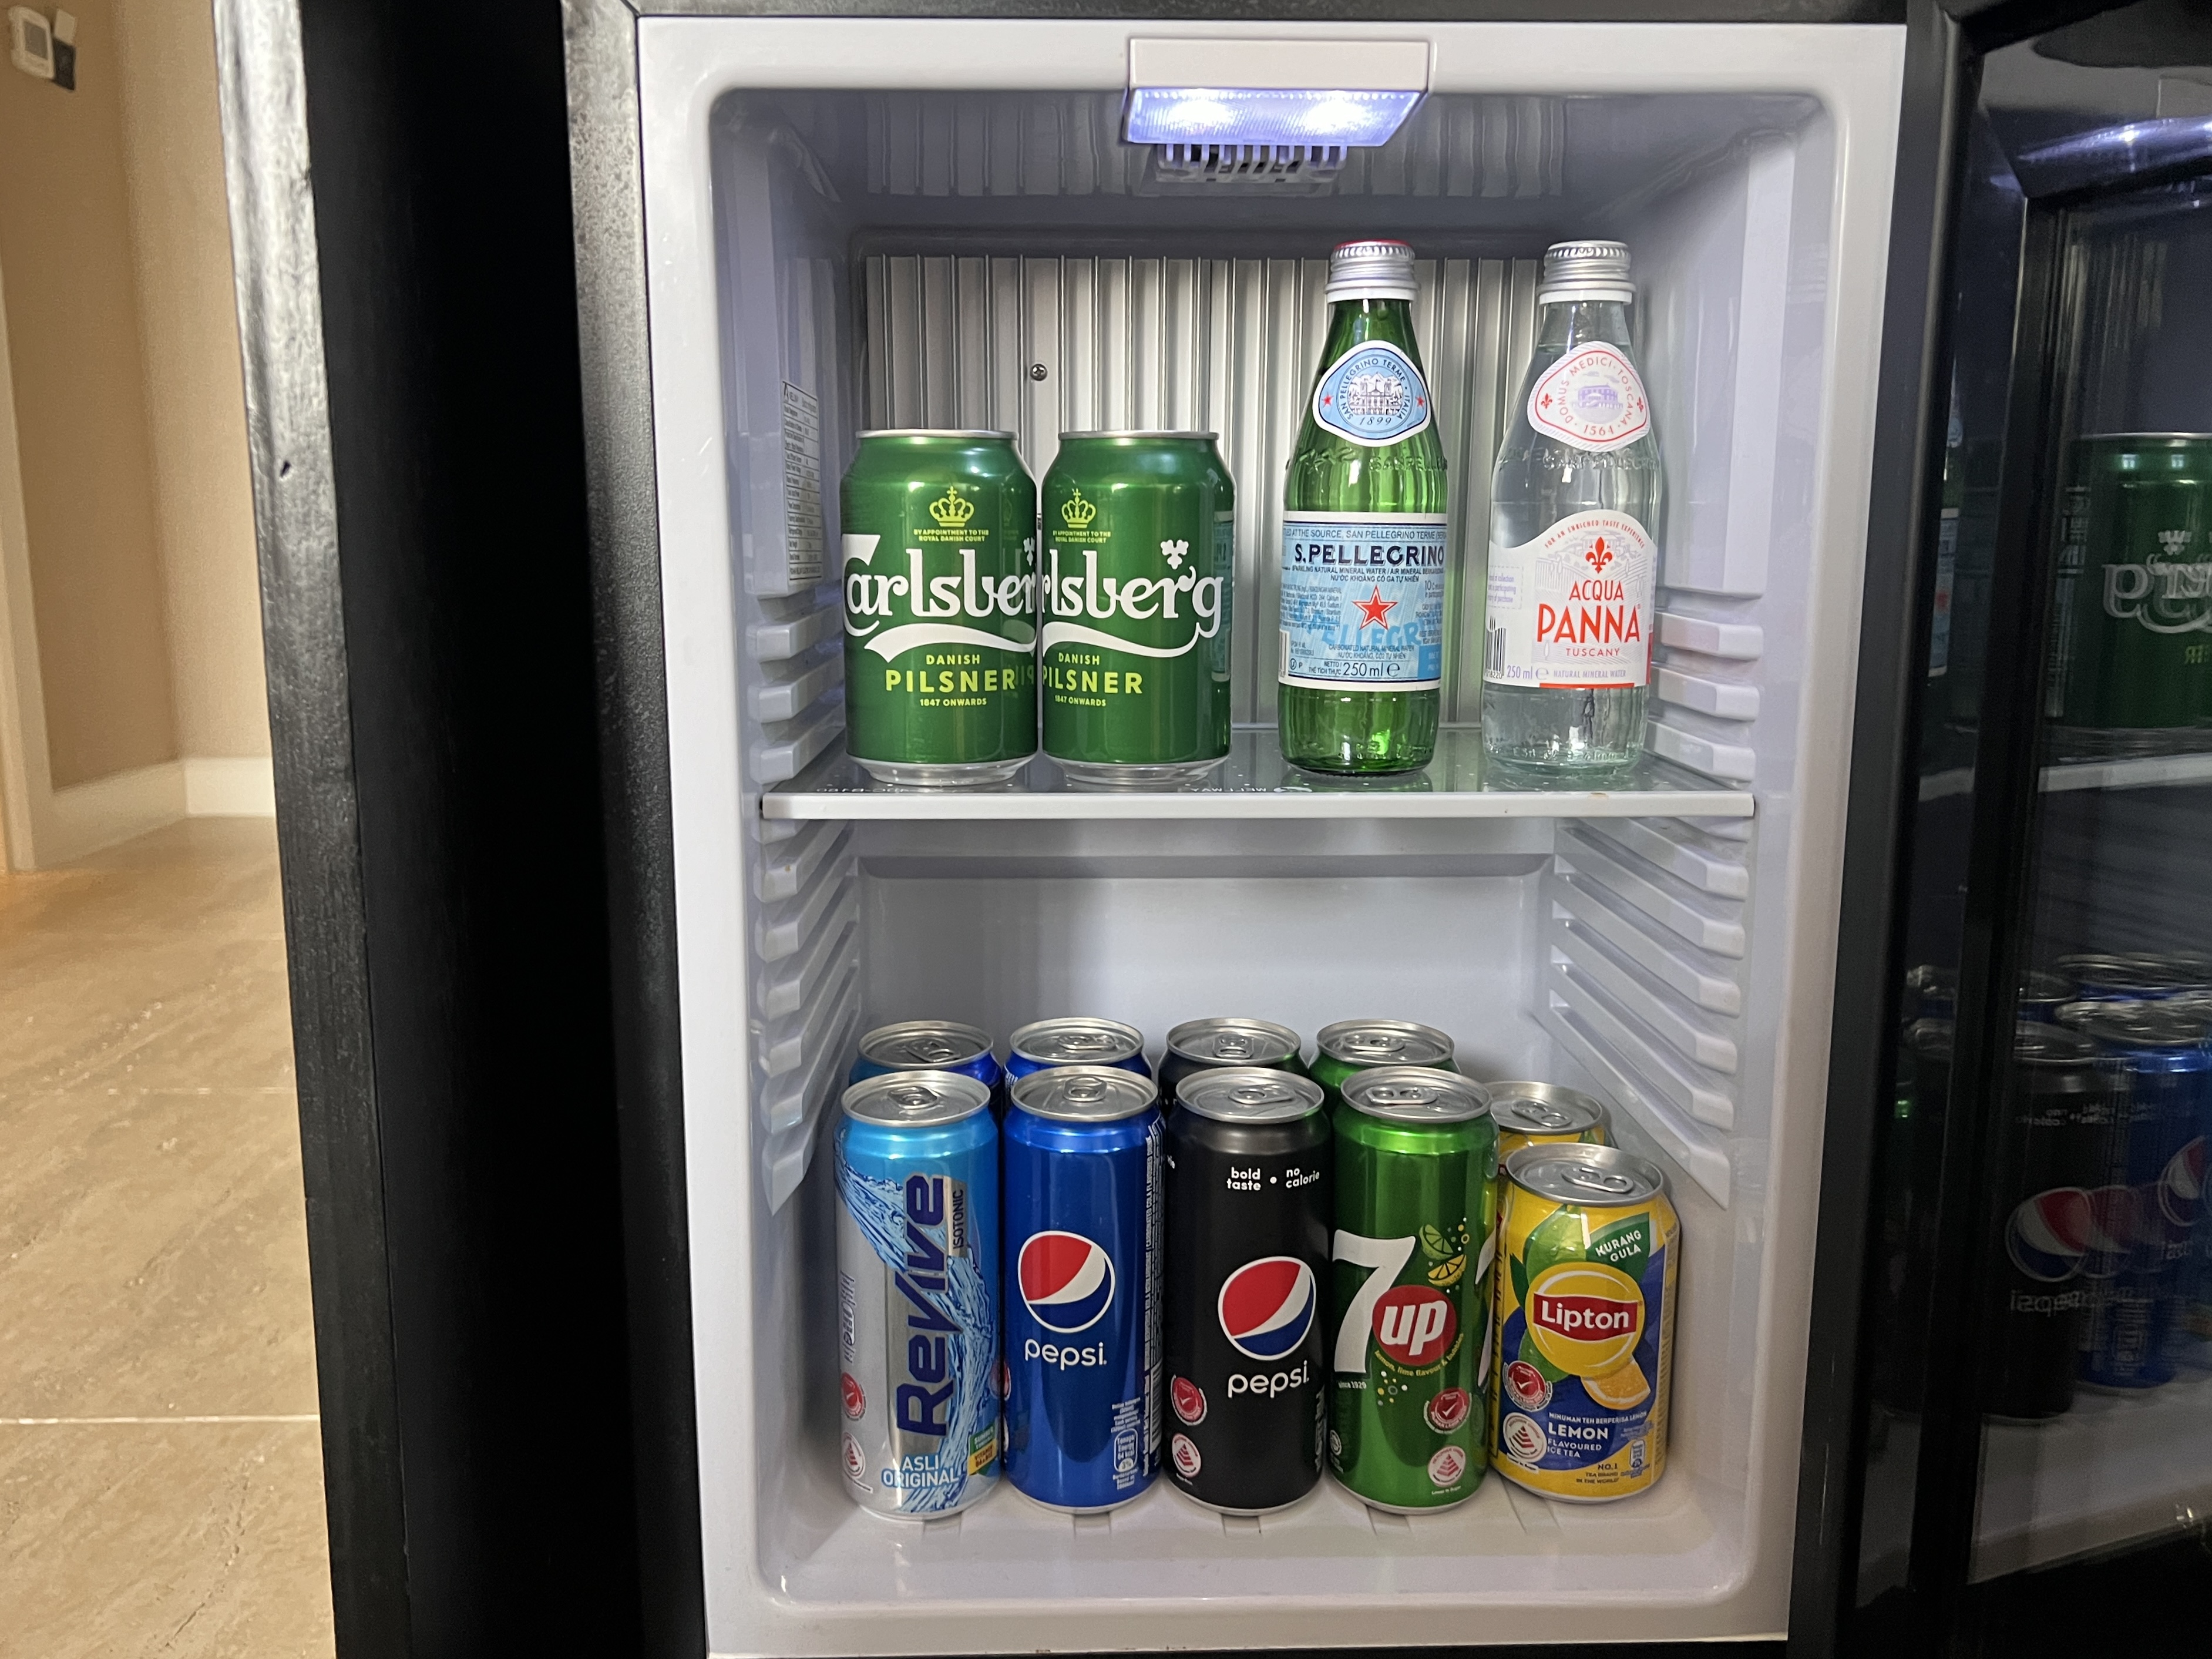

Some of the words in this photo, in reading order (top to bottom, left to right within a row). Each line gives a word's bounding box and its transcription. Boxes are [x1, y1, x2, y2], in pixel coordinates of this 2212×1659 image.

[1340, 358, 1379, 400] PELLEGRINO
[1382, 360, 1406, 382] TERME
[1557, 380, 1574, 424] DOMUS
[1569, 357, 1612, 377] MEDICI
[1618, 369, 1635, 425] TOSCANA
[1340, 403, 1353, 420] SAN
[1397, 395, 1410, 421] ITALIA
[1359, 417, 1392, 426] 1899
[1583, 424, 1614, 436] 1564
[1545, 538, 1556, 549] FOR
[1568, 520, 1599, 533] ENRICHED
[1602, 520, 1619, 528] TASTE
[1621, 523, 1645, 549] EXPERIENCE
[1295, 543, 1444, 566] S.PELLEGRINO
[1569, 580, 1624, 602] ACQUA
[1537, 603, 1640, 643] PANNA
[926, 654, 980, 666] DANISH
[1058, 653, 1100, 664] DANISH
[1566, 648, 1620, 656] TUSCANY
[1343, 663, 1367, 676] 250
[1370, 663, 1384, 677] ml
[1507, 665, 1521, 678] 250
[1523, 666, 1533, 679] ml
[1553, 670, 1580, 678] NATURAL
[1582, 670, 1608, 678] MINERAL
[886, 669, 1016, 693] PILSNER
[920, 697, 940, 707] 1847
[942, 697, 987, 707] ONWARDS
[1068, 696, 1107, 707] ONWARDS
[1231, 1167, 1260, 1180] bold
[1286, 1167, 1300, 1178] no
[1286, 1170, 1320, 1188] calorie
[1226, 1178, 1262, 1191] taste
[953, 1188, 964, 1250] ISOTONIC
[1595, 1229, 1642, 1257] KURANG
[1610, 1244, 1642, 1262] GULA
[1542, 1300, 1629, 1332] Lipton
[1374, 1350, 1395, 1372] lemon,
[1397, 1366, 1414, 1376] lime
[1416, 1365, 1441, 1376] flavour
[1447, 1333, 1464, 1361] bubbles
[1227, 1360, 1307, 1399] pepsi
[1549, 1412, 1581, 1423] MINUMAN
[1629, 1411, 1647, 1421] LEMON
[1548, 1422, 1608, 1440] LEMON
[1548, 1438, 1602, 1450] FLAVOURED
[1547, 1448, 1562, 1457] ICE
[1564, 1449, 1581, 1458] TEA
[902, 1456, 939, 1472] ASLI
[883, 1470, 959, 1487] ORIGINAL
